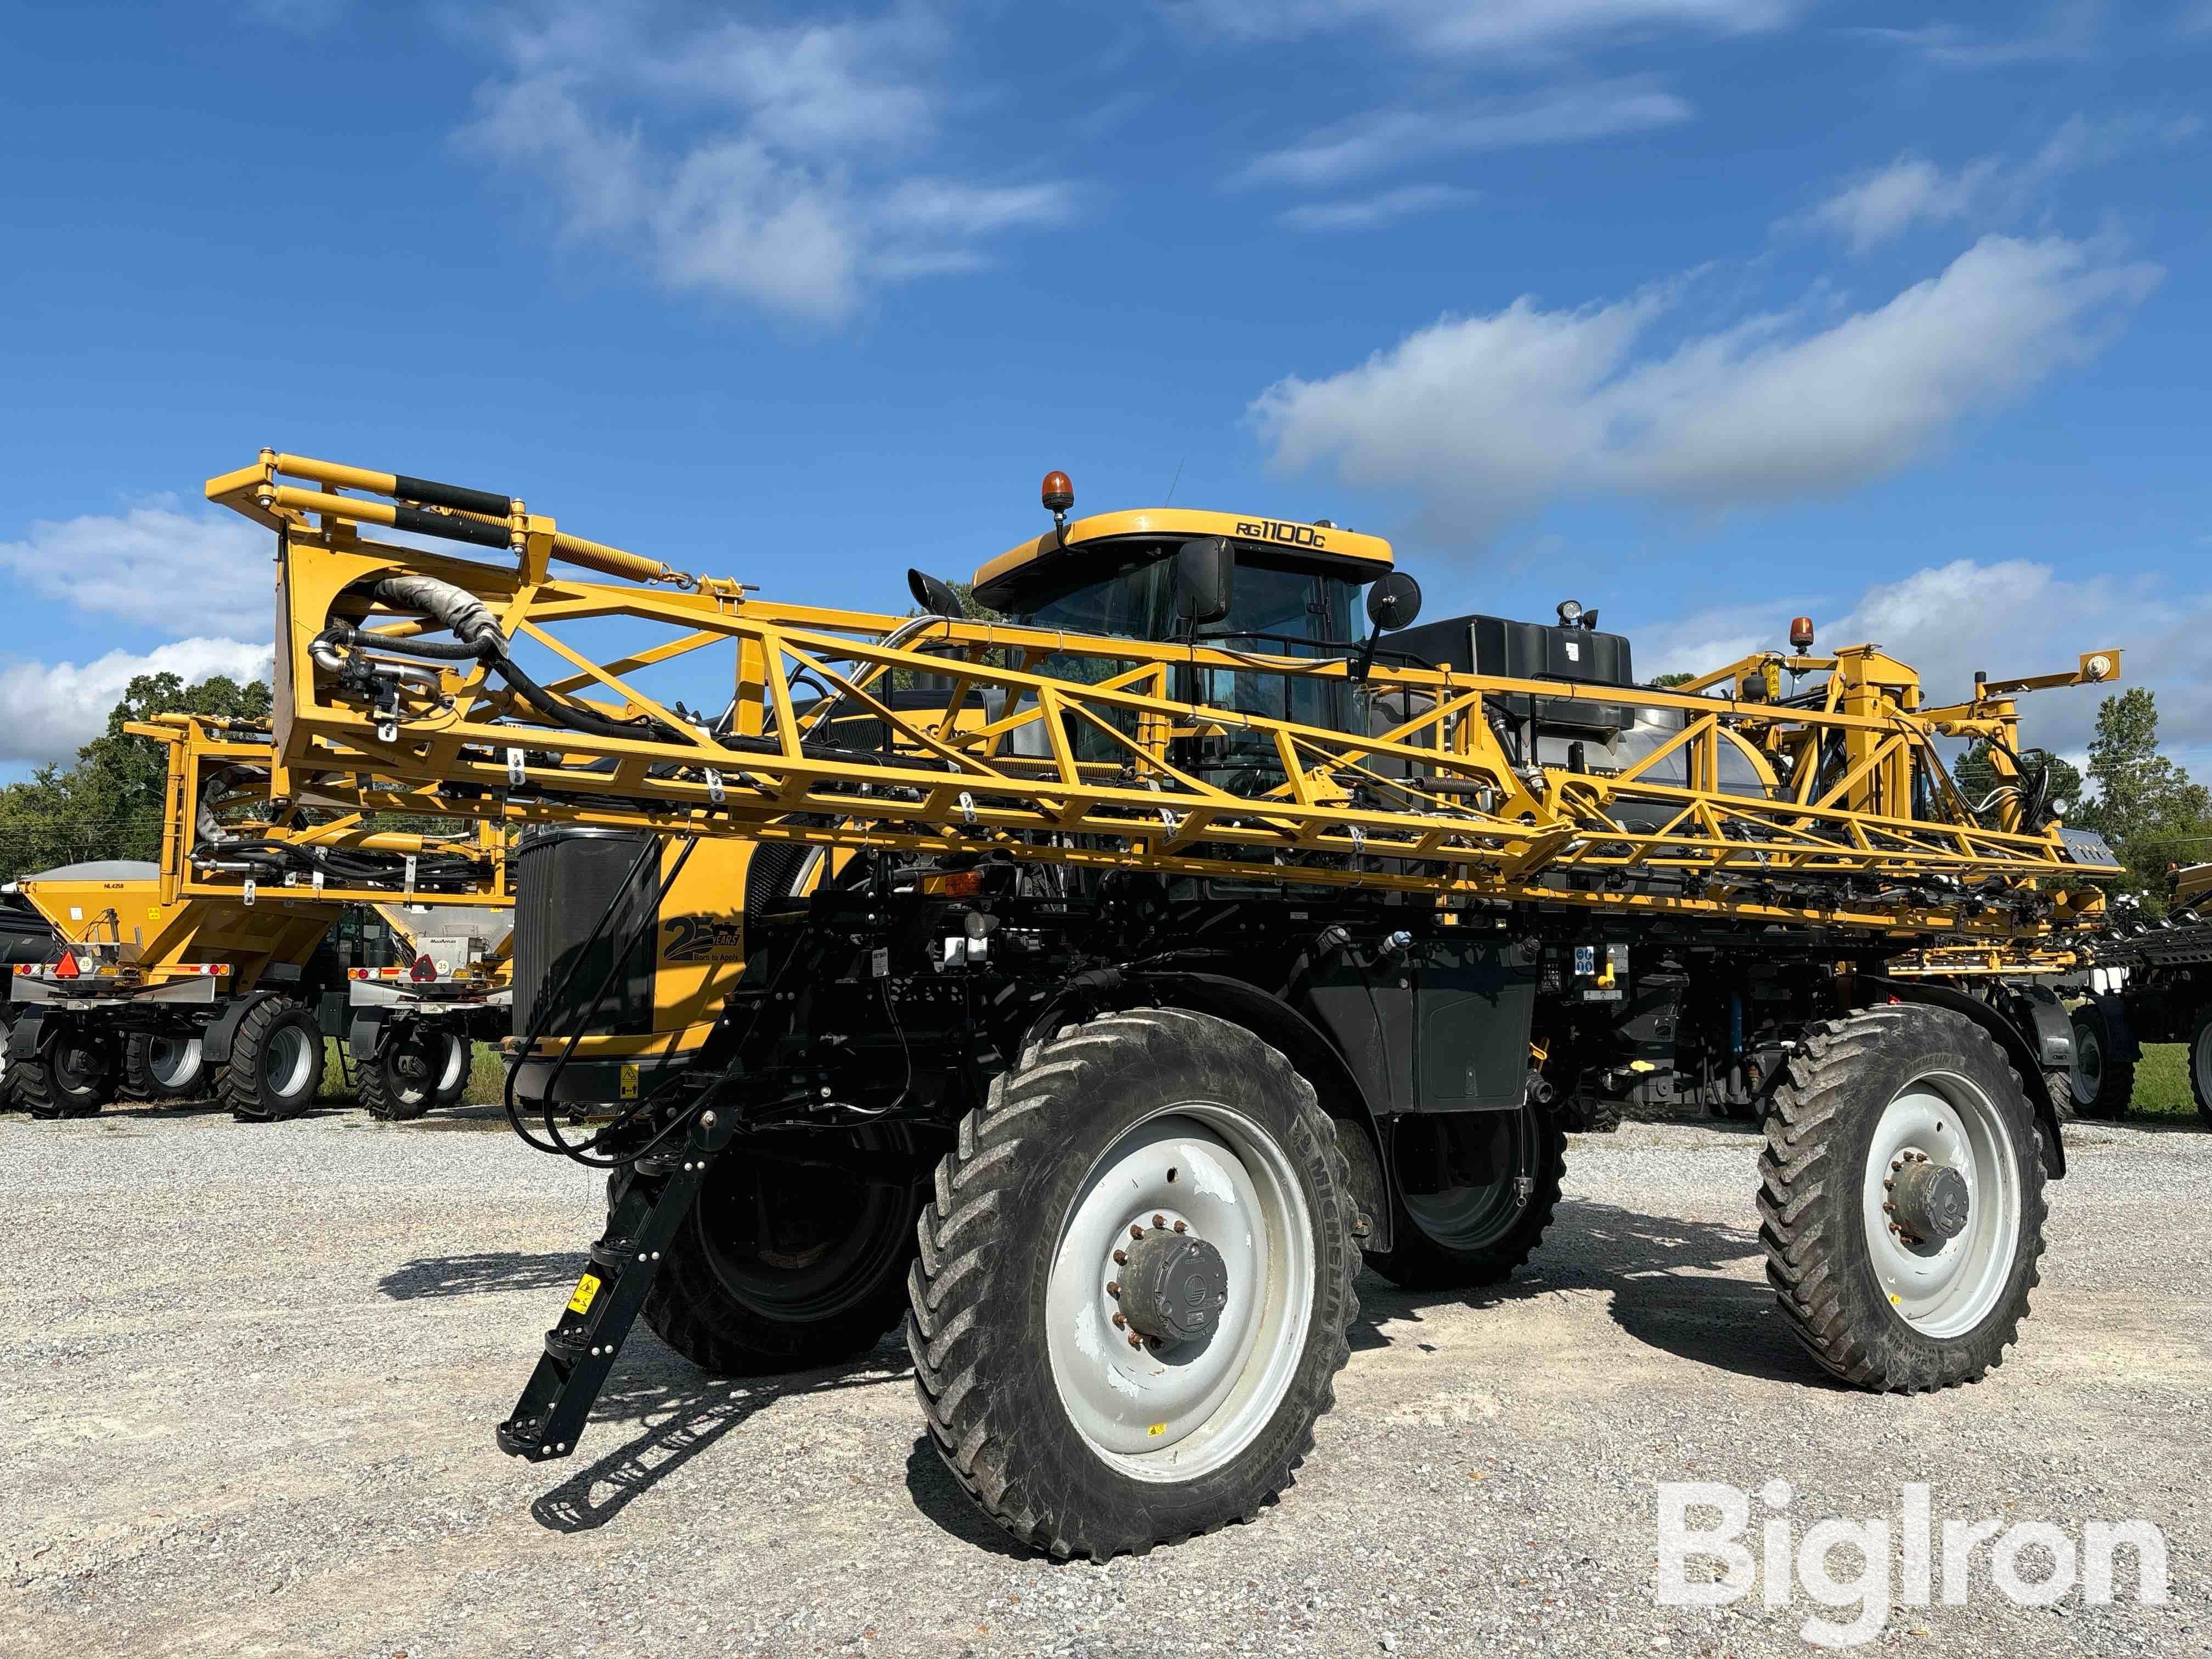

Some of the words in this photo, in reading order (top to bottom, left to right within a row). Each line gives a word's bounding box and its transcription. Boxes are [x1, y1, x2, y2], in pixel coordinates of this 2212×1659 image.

[712, 934, 738, 946] YEARS
[719, 953, 738, 962] Apply
[1307, 1154, 1344, 1333] MICHELIN
